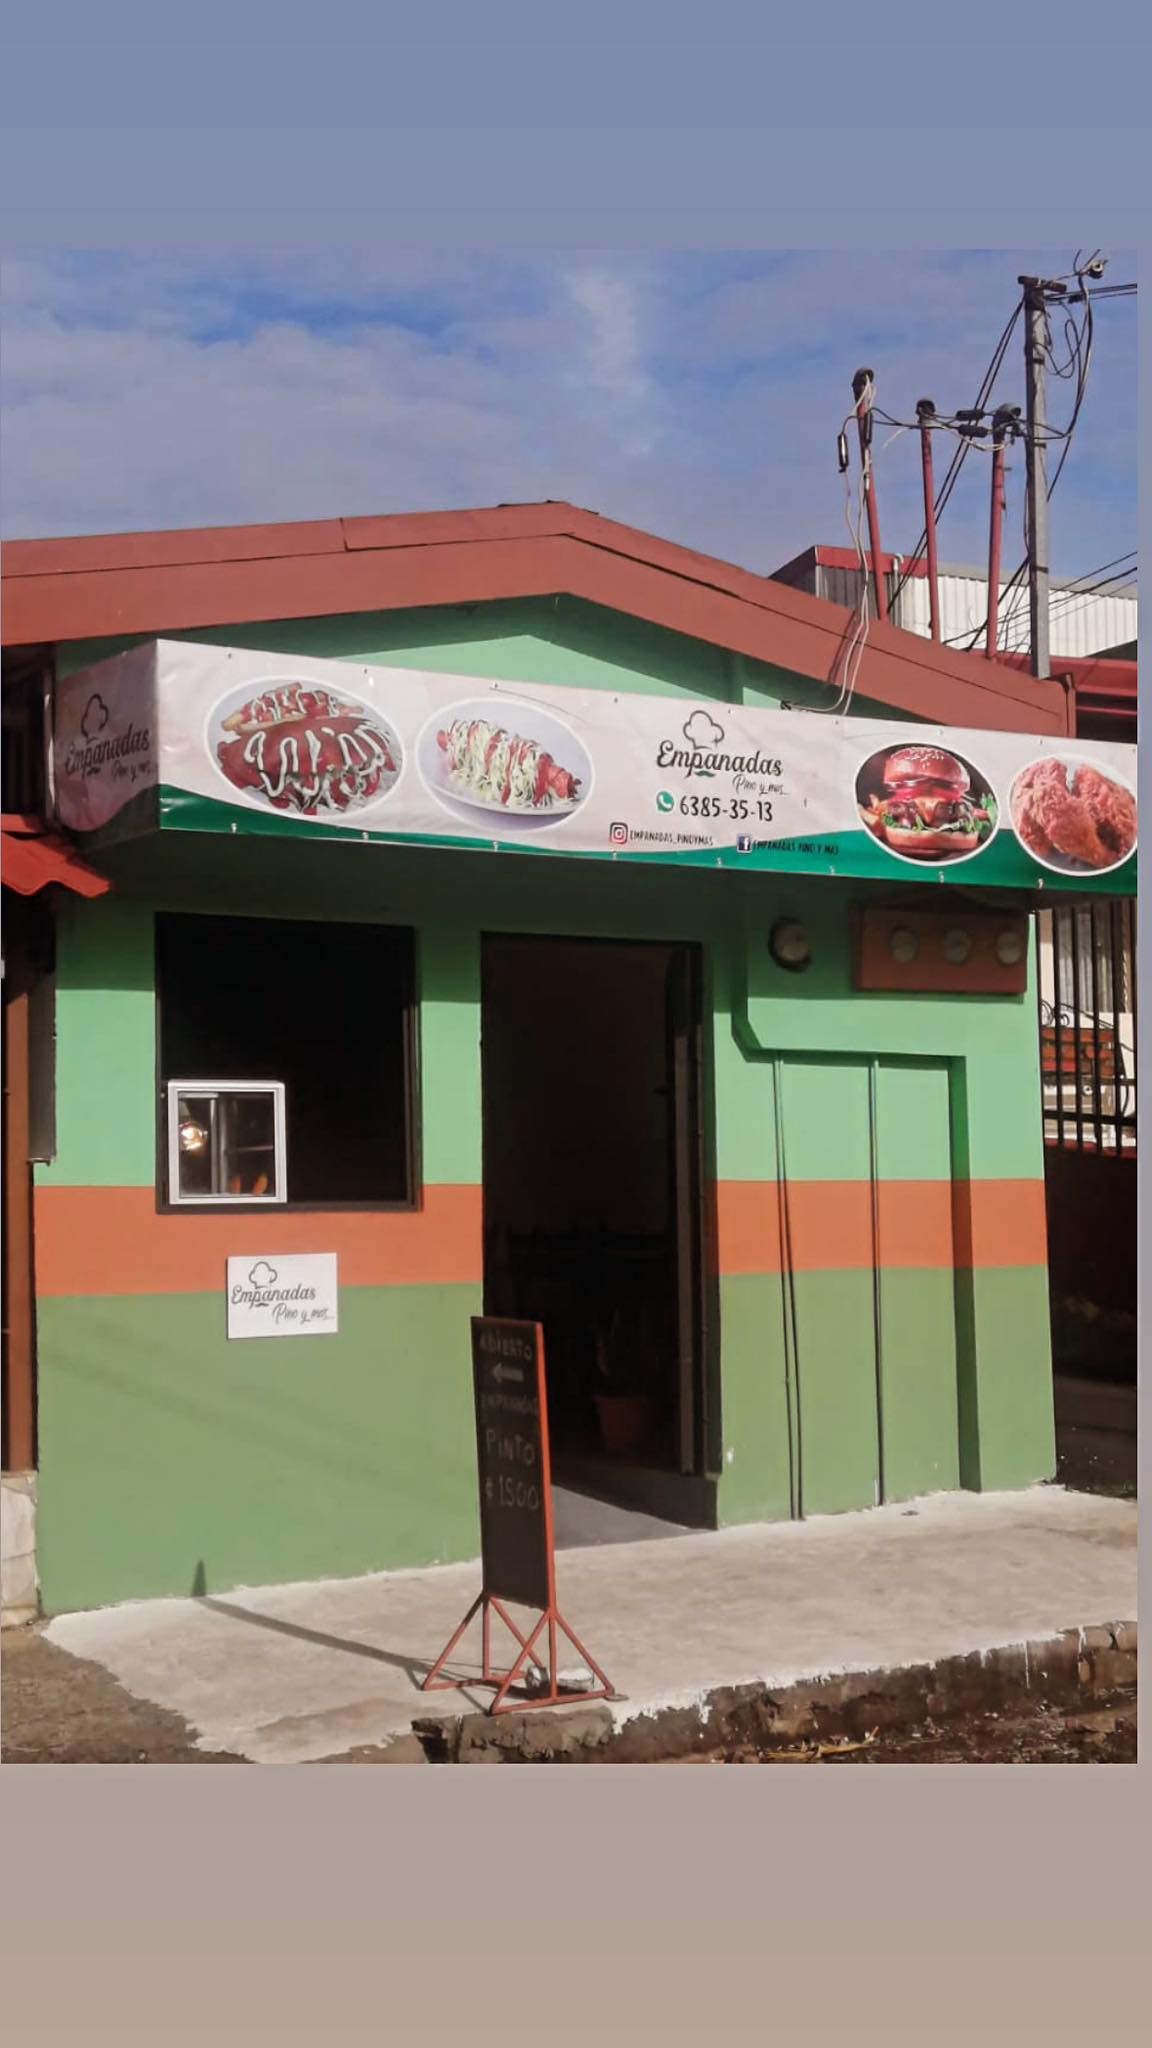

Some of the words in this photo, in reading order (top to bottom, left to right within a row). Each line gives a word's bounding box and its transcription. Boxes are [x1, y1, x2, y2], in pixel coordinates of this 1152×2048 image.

[65, 723, 150, 779] Empanadas
[656, 739, 784, 778] Empanadas
[758, 782, 769, 797] y
[679, 795, 774, 822] 6385-35-13
[230, 1283, 317, 1309] Empanadas
[300, 1309, 312, 1325] y
